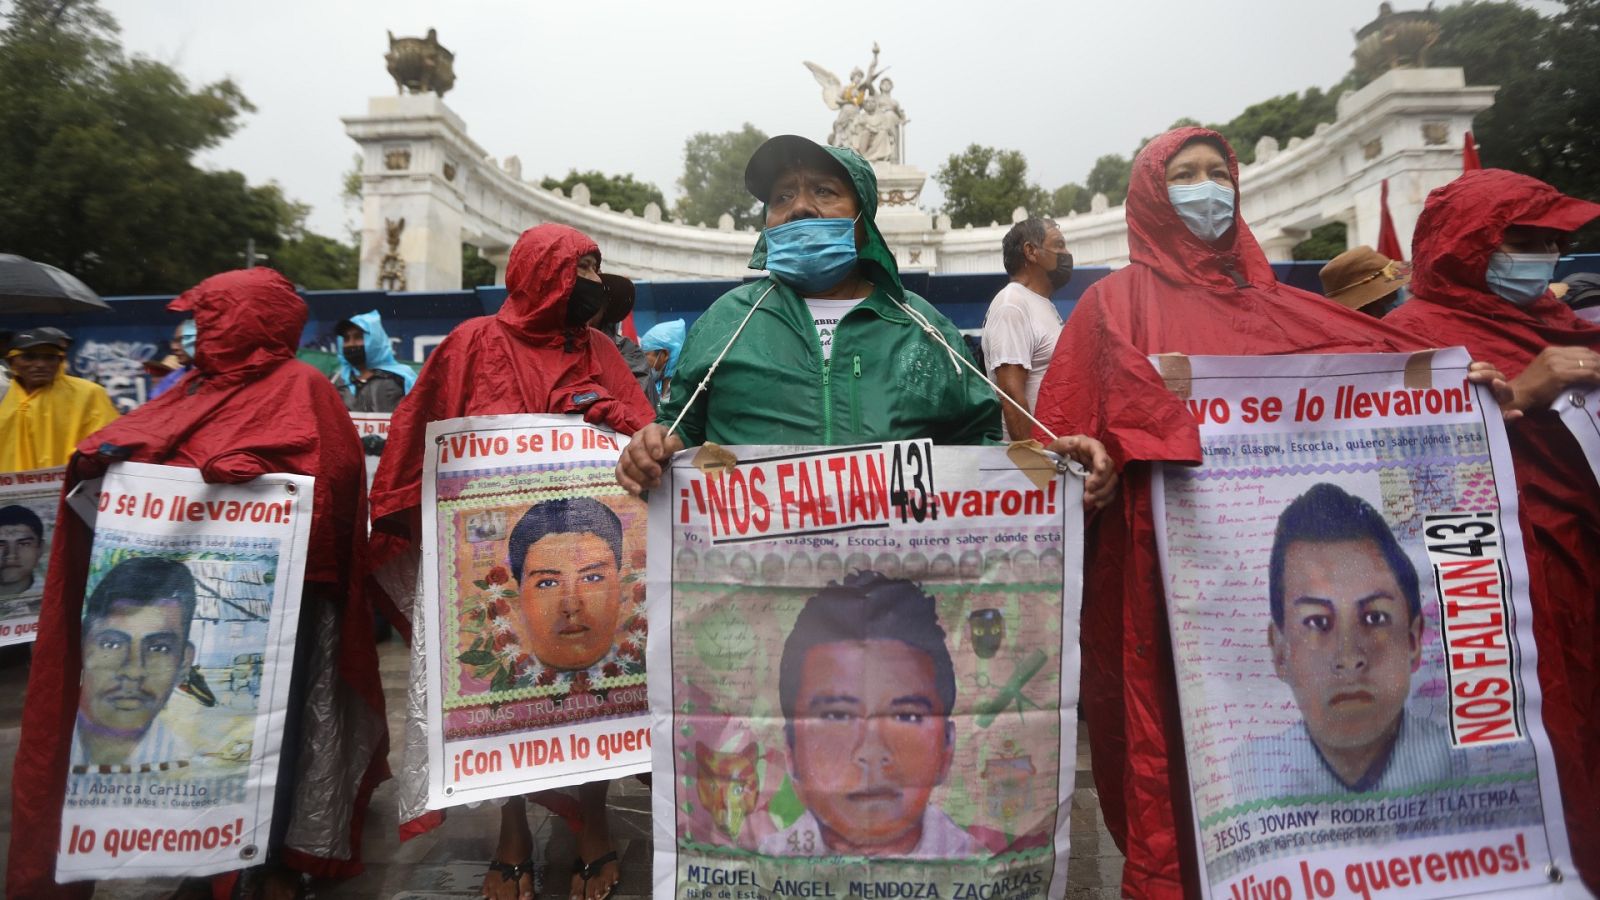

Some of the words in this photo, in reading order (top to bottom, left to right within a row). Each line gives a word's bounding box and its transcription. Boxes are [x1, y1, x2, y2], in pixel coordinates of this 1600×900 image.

[1241, 396, 1282, 423] se
[1294, 388, 1324, 422] lo
[1334, 379, 1473, 420] llevaron!
[441, 432, 509, 464] ¡Vivo
[516, 433, 544, 453] se
[552, 429, 574, 452] lo
[1202, 445, 1235, 457] Nimmo,
[1241, 444, 1285, 456] Glasgow,
[1291, 440, 1340, 453] Escocia,
[1346, 437, 1386, 451] quiero
[1391, 434, 1418, 447] saber
[1457, 430, 1482, 443] está
[115, 494, 136, 516] se
[142, 492, 164, 519] lo
[168, 495, 292, 524] llevaron!
[705, 466, 770, 537] NOS
[777, 453, 889, 530] FALTAN
[891, 442, 937, 524] 43!
[684, 531, 703, 544] Yo,
[848, 536, 901, 549] Escocia,
[909, 536, 950, 548] quiero
[956, 534, 988, 545] saber
[1034, 531, 1061, 543] está
[1425, 512, 1497, 557] 43!
[1439, 558, 1508, 671] FALTAN
[467, 704, 515, 724] JONÁS
[526, 694, 604, 717] TRUJILLO
[1454, 677, 1516, 744] NOS
[454, 749, 502, 782] ¡Con
[509, 737, 565, 769] VIDA
[569, 734, 590, 761] lo
[89, 783, 141, 795] Abarca
[149, 784, 208, 797] Carillo
[68, 825, 96, 855] lo
[103, 818, 245, 858] queremos!
[1213, 820, 1251, 852] JESÚS
[1258, 810, 1320, 835] JOVANY
[1331, 800, 1427, 824] RODRÍGUEZ
[1439, 789, 1520, 813] TLATEMPA
[787, 831, 816, 852] 43
[687, 864, 761, 888] MIGUEL
[772, 876, 836, 898] ÁNGEL
[849, 881, 939, 899] MENDOZA
[953, 870, 1043, 900] ZACARIAS
[1228, 874, 1292, 900] Vivo
[1299, 861, 1335, 900] lo
[1345, 833, 1530, 900] queremos!
[718, 888, 731, 899] de
